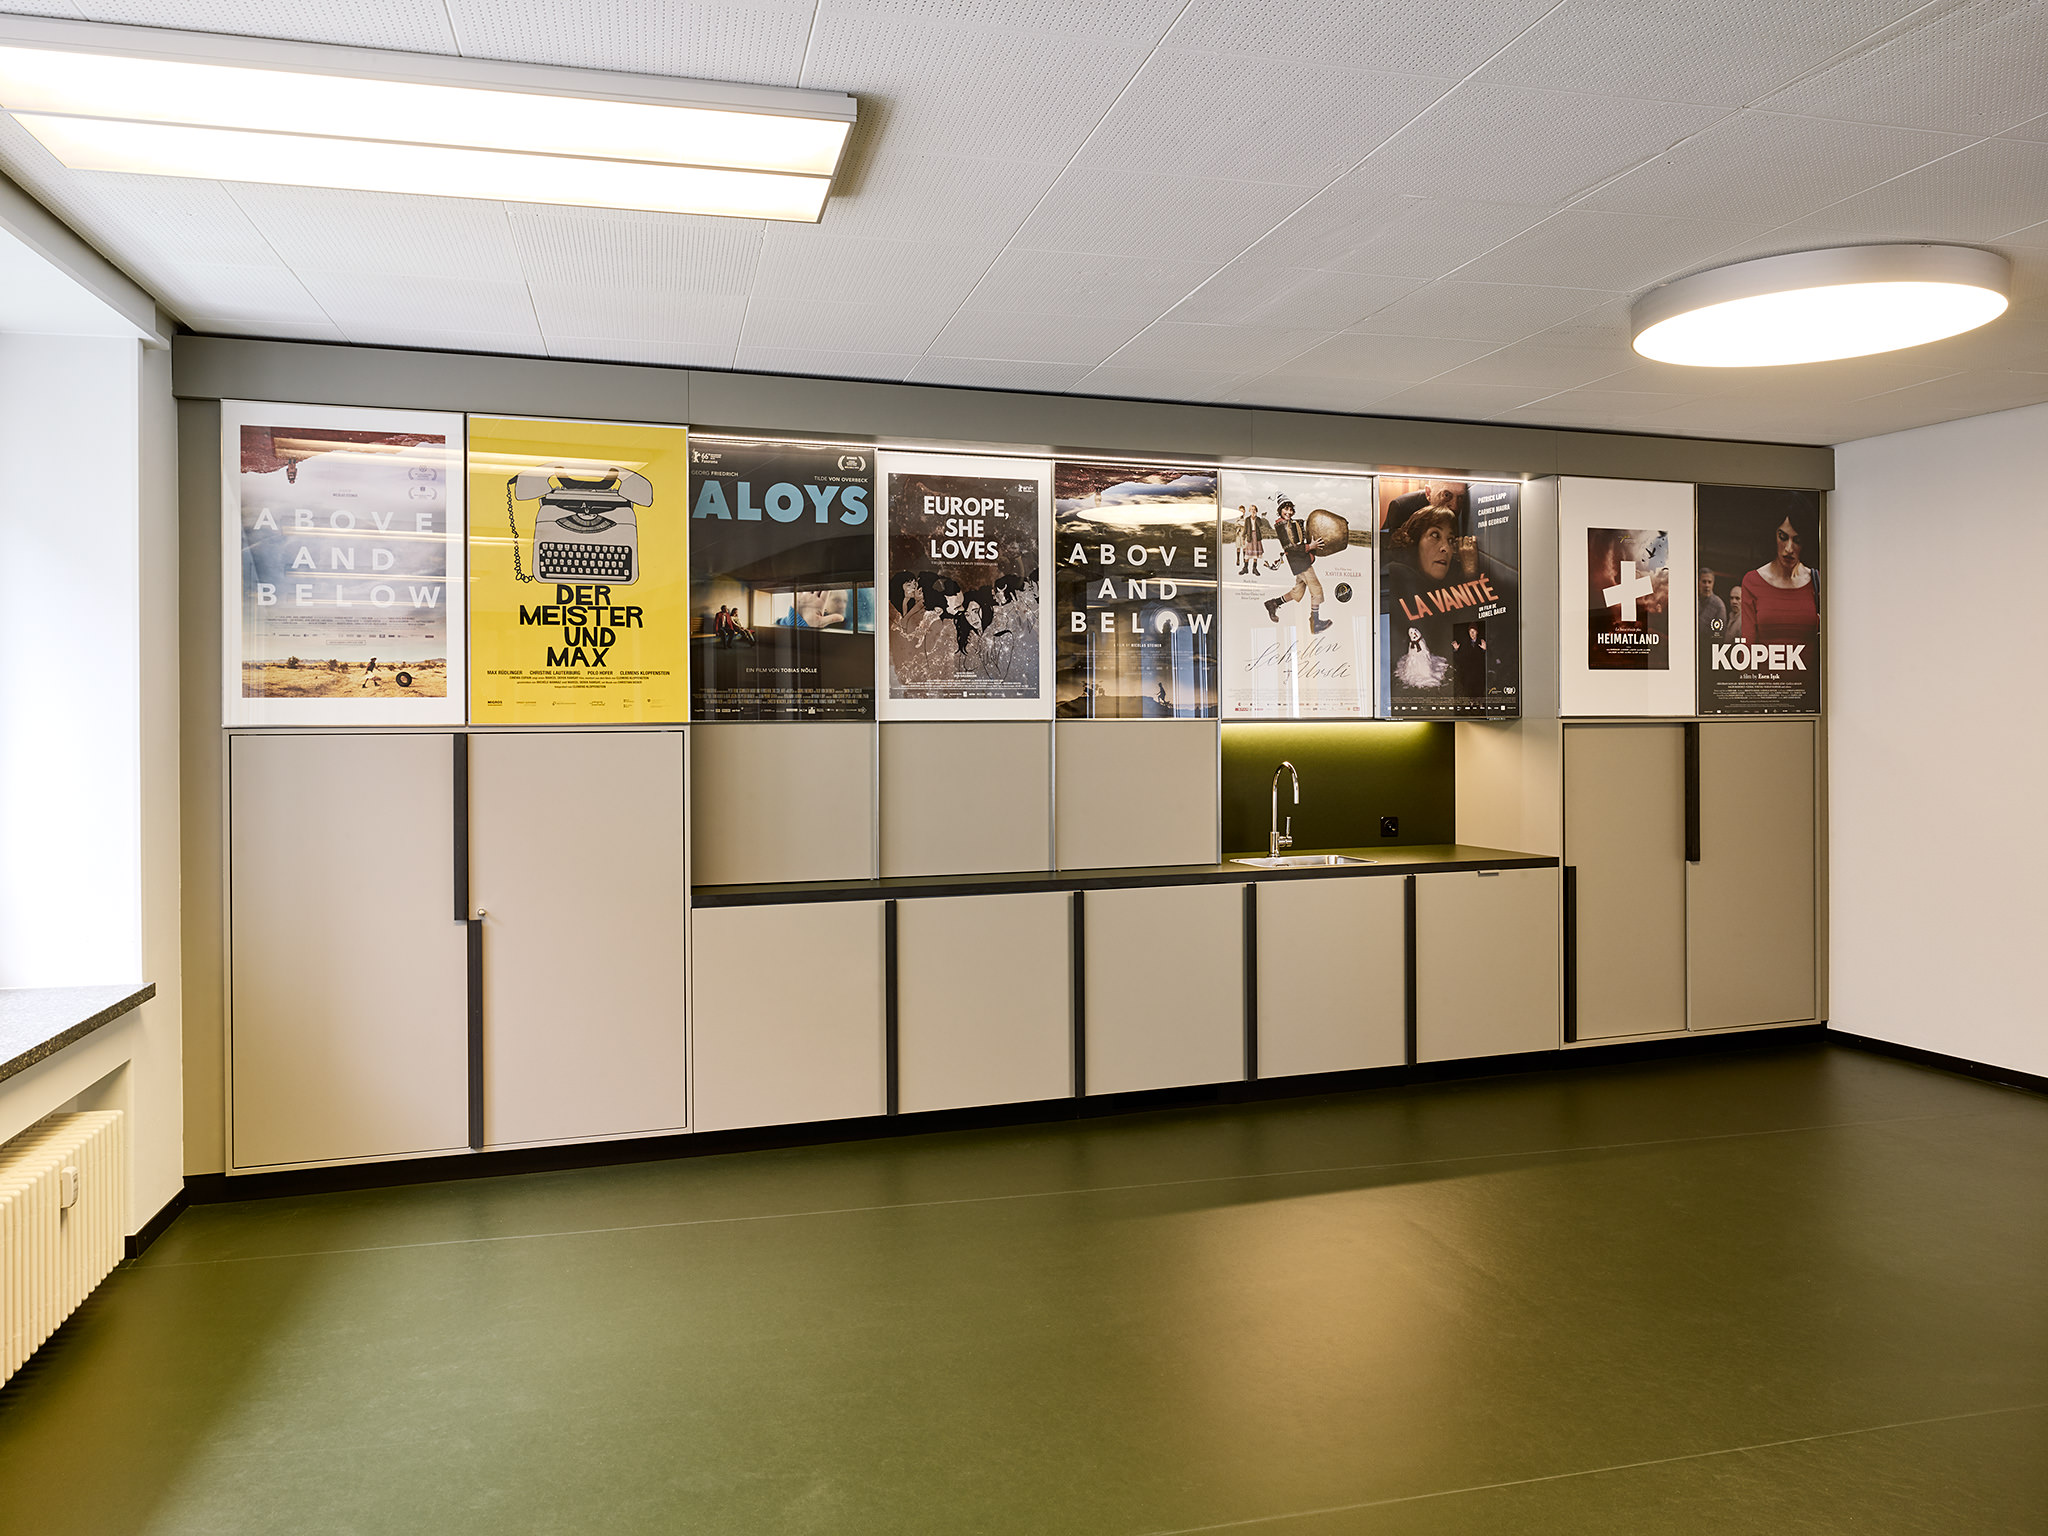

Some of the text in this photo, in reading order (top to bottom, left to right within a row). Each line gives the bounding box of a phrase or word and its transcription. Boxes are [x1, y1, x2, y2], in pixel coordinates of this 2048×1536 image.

[692, 480, 869, 525] ALOYS
[924, 495, 1010, 520] EUROPE,
[1477, 492, 1507, 504] PATRICK LAPP
[253, 507, 433, 534] ABOVE
[1477, 504, 1510, 516] CARMEN MAURA
[1488, 516, 1509, 526] GEORGIEV
[944, 518, 985, 538] SHE
[291, 546, 395, 571] AND
[931, 539, 999, 560] LOVES
[1069, 543, 1208, 568] ABOVE
[257, 582, 441, 609] BELOW
[556, 584, 612, 606] DER
[1097, 577, 1178, 600] AND
[1399, 573, 1499, 621] LA VANITÉ
[519, 605, 644, 628] MEISTER
[1071, 609, 1213, 634] BELOW
[1478, 606, 1507, 619] LIONEL BAIER
[564, 626, 616, 647] UND
[1597, 632, 1660, 645] HEIMATLAND
[546, 646, 609, 667] MAX
[1711, 637, 1807, 671] KÖPEK
